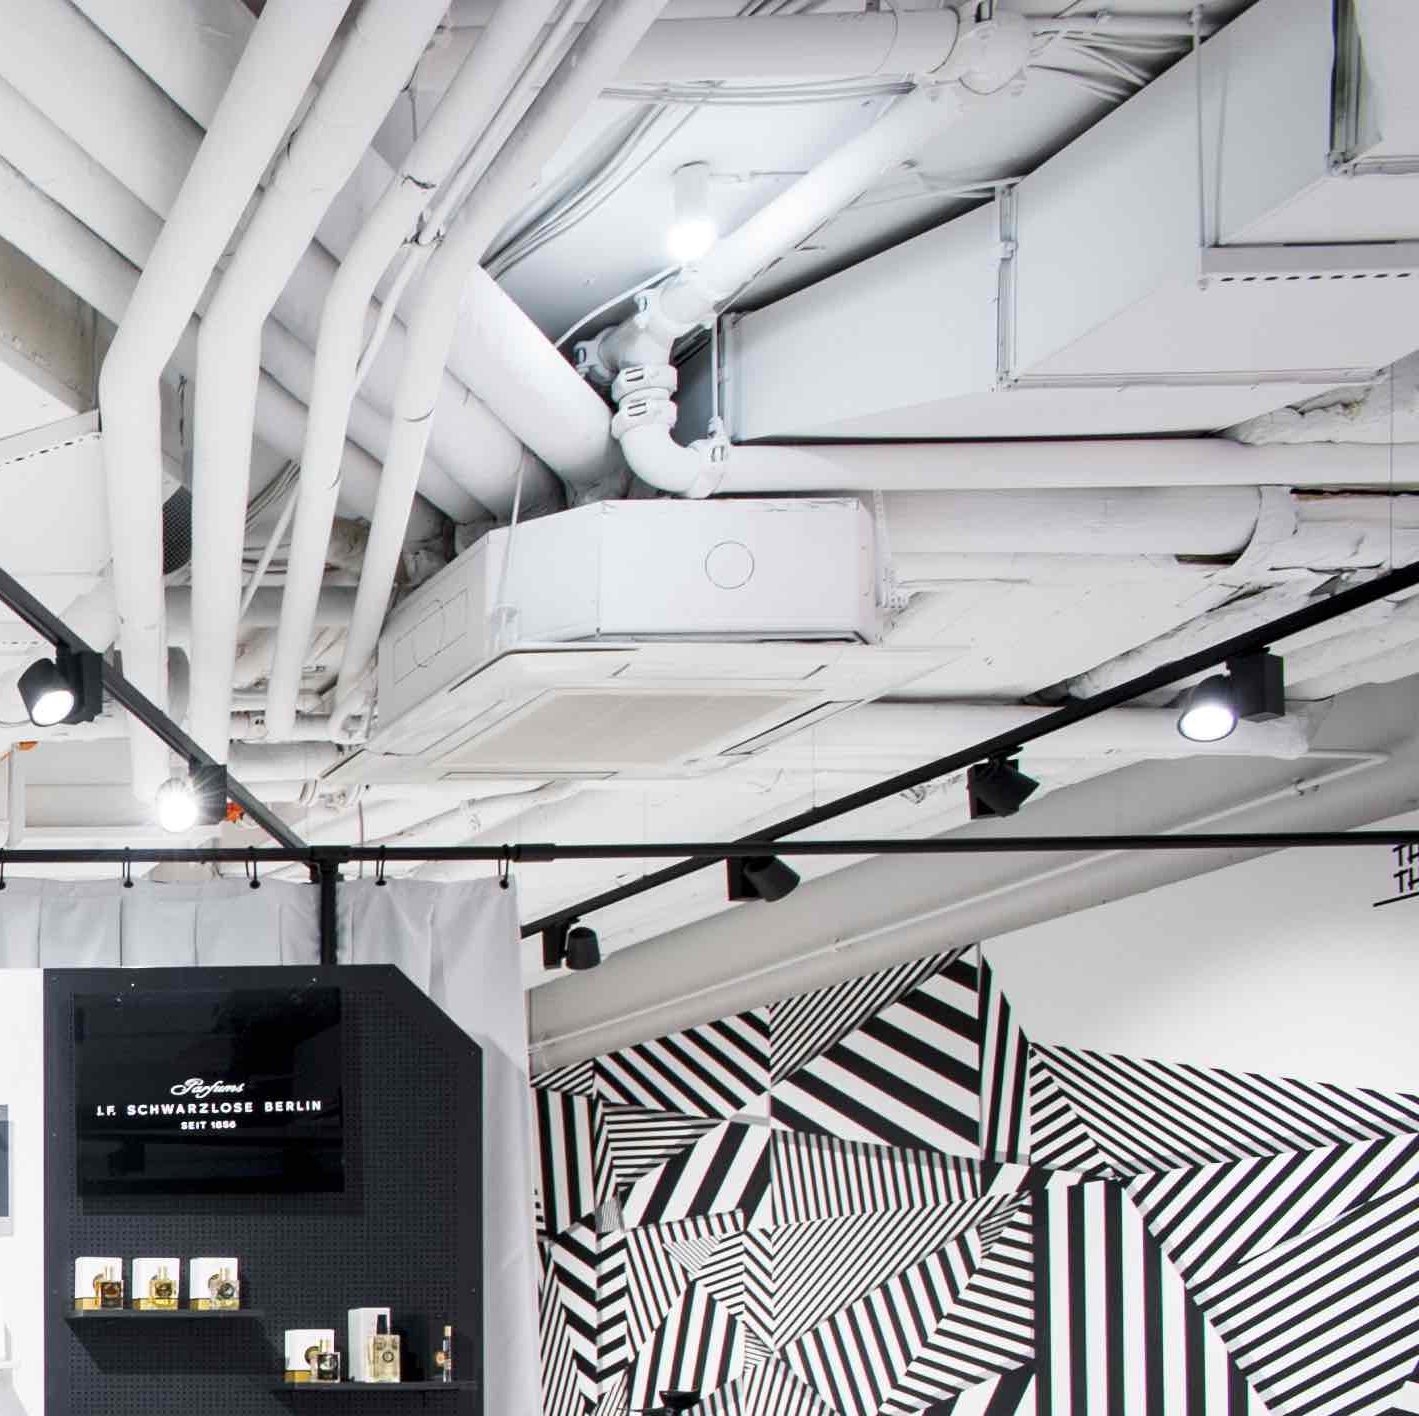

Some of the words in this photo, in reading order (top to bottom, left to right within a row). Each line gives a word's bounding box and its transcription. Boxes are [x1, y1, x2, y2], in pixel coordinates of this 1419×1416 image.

[170, 1078, 246, 1099] Parfums
[126, 1101, 254, 1116] SCHWARZLOSE
[264, 1100, 322, 1113] BERLIN
[180, 1121, 207, 1131] SEIT
